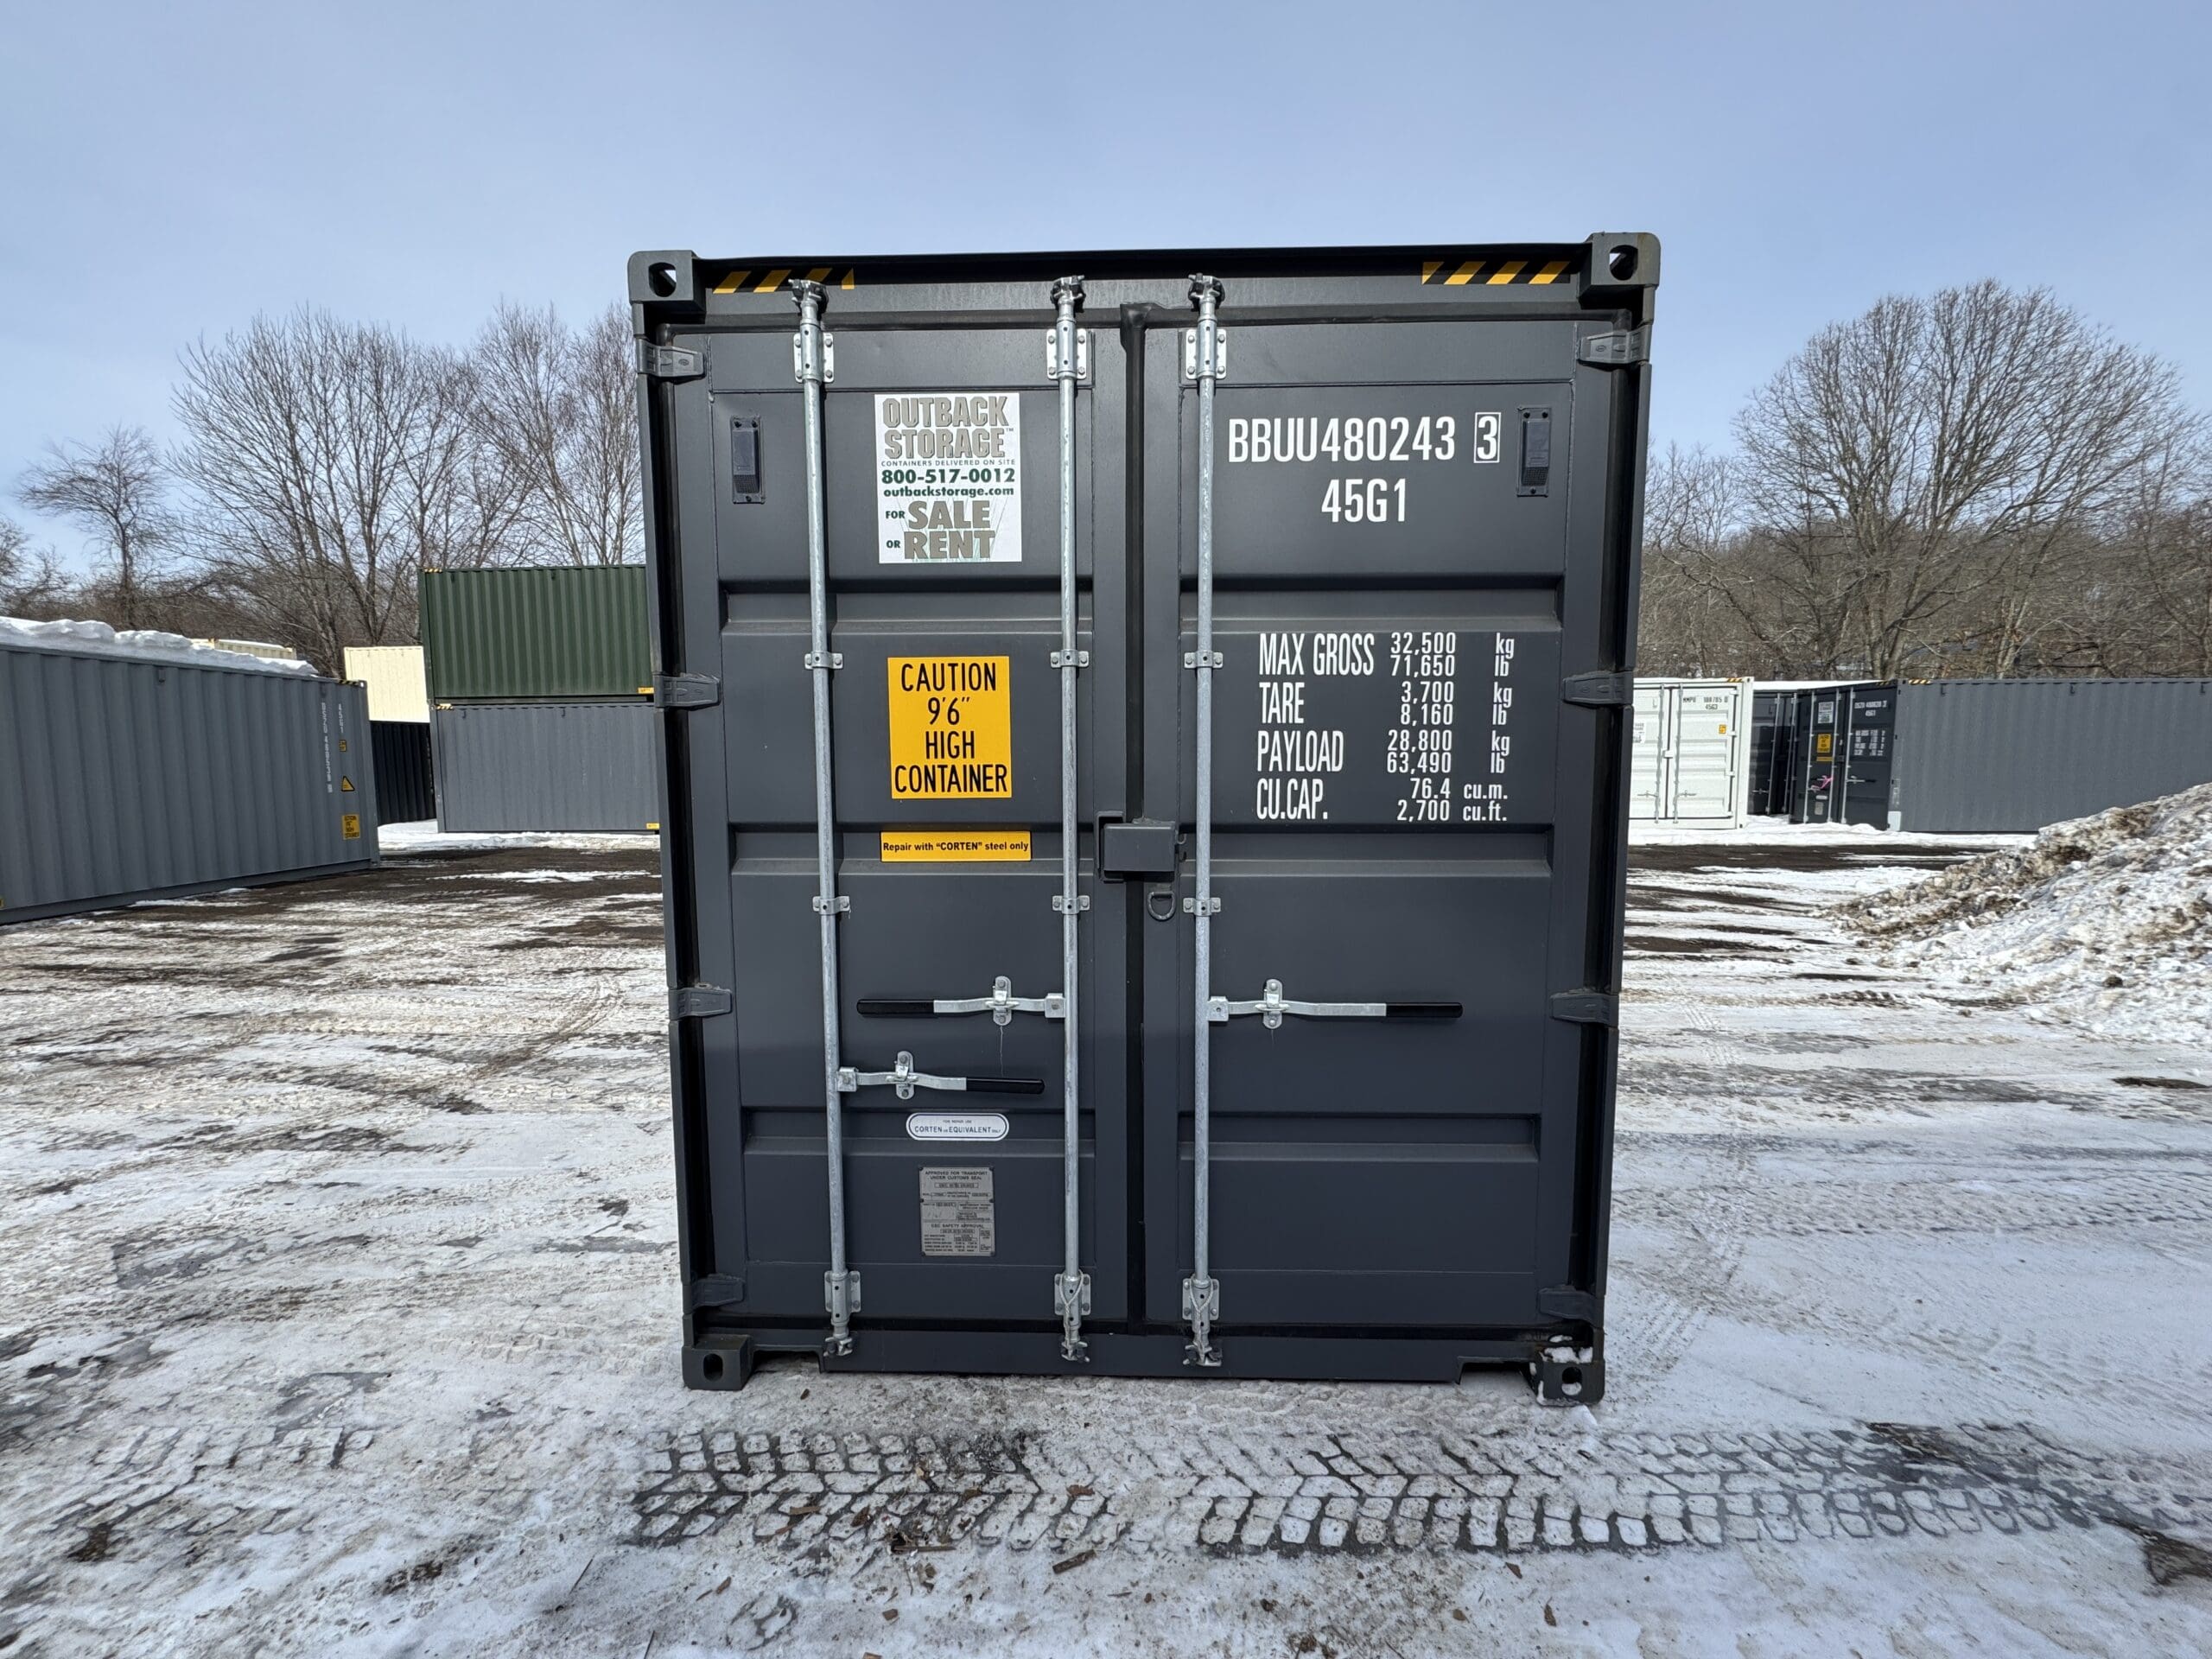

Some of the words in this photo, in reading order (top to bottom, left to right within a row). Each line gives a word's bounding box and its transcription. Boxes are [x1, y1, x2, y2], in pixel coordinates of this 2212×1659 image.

[882, 396, 1009, 428] OUTBACK
[884, 428, 1005, 459] STORAGE
[1228, 416, 1456, 463] BBUU480243
[1477, 416, 1497, 460] 3
[881, 467, 1015, 484] 800-517-0012
[883, 486, 1014, 498] outbackstorage.com
[1320, 478, 1406, 523] 45G1
[885, 511, 906, 519] FOR
[908, 500, 991, 530] SALE
[886, 540, 900, 549] OR
[904, 531, 995, 559] RENT
[1259, 632, 1305, 676] MAX
[1313, 632, 1375, 676] GROSS
[1390, 632, 1456, 655] 32,500
[1495, 632, 1515, 659] kg
[1390, 654, 1455, 678] 71,650
[1494, 656, 1510, 677] lb
[901, 662, 996, 691] CAUTION
[1259, 682, 1305, 724] TARE
[1401, 681, 1454, 705] 3,700
[1493, 682, 1512, 708] kg
[1400, 703, 1453, 727] 8,160
[1492, 704, 1507, 726] lb
[925, 731, 975, 760] HIGH
[1257, 730, 1344, 772] PAYLOAD
[1387, 729, 1452, 753] 28,800
[1491, 730, 1510, 757] kg
[1387, 752, 1452, 775] 63,490
[1491, 752, 1505, 773] lb
[894, 764, 1007, 793] CONTAINER
[1256, 778, 1328, 820] CU.CAP.
[1409, 778, 1451, 799] 76.4
[1463, 784, 1508, 800] cu.m.
[1396, 799, 1450, 823] 2,700
[1462, 804, 1507, 822] cu.ft.
[883, 842, 912, 853] Repair
[914, 842, 933, 851] with
[985, 841, 1007, 850] steel
[1009, 841, 1028, 851] only
